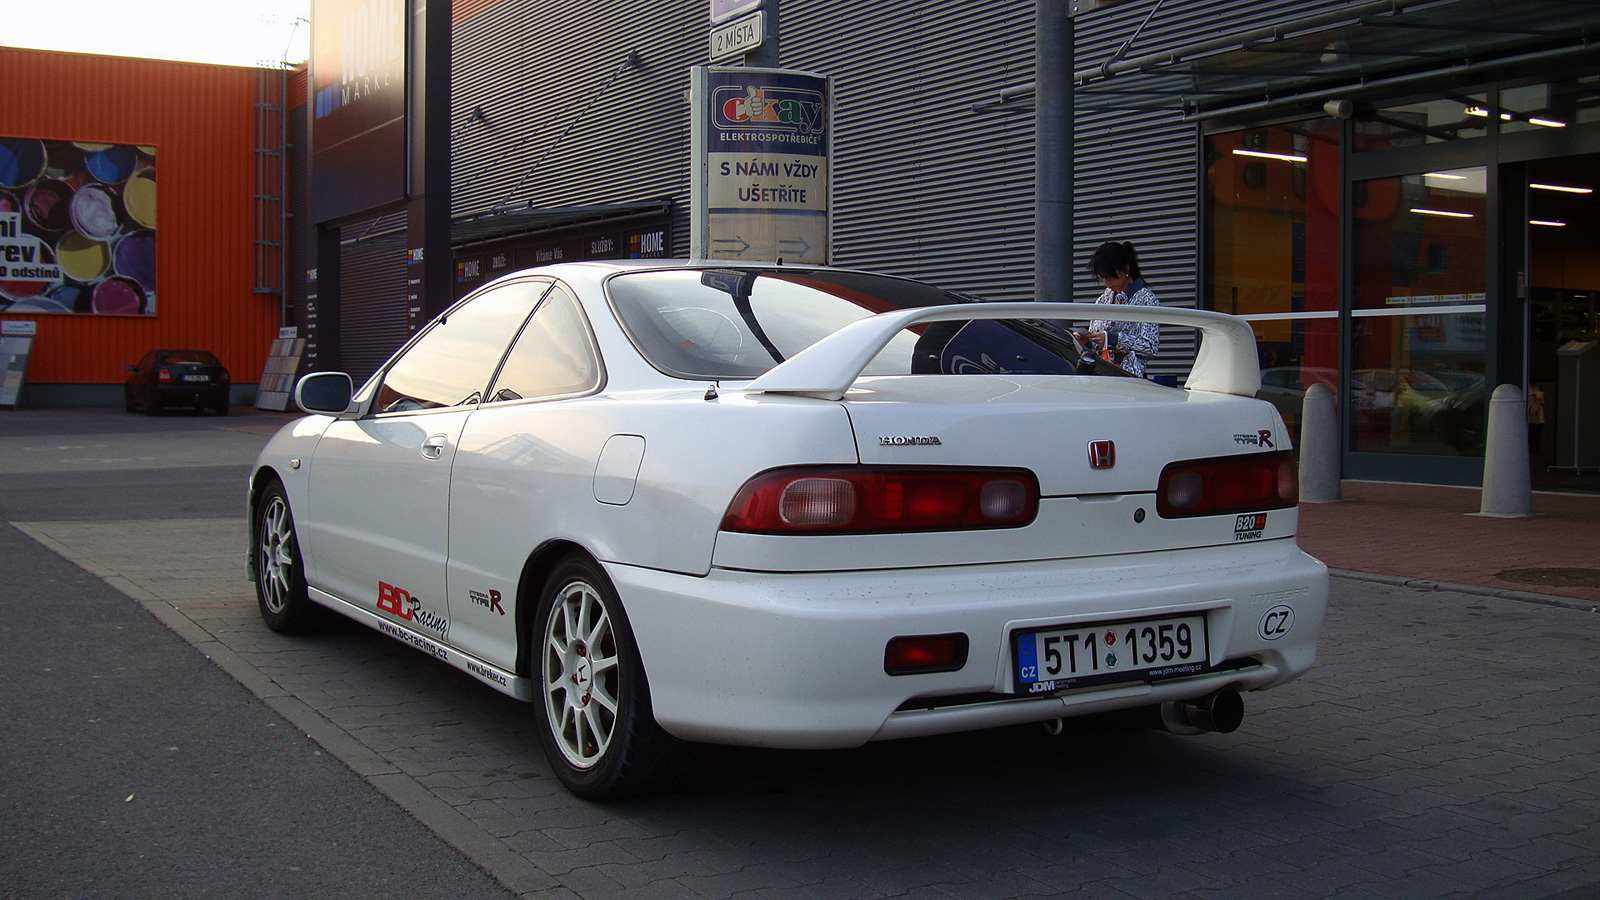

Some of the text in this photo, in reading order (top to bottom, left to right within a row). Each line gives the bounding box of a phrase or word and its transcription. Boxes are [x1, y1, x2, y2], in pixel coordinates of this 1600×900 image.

[717, 23, 754, 52] 2 MÍSTA
[341, 60, 401, 107] MARKET
[720, 132, 818, 145] ELEKTROSPOTŘEBIČE
[720, 158, 818, 178] S NÁMI VŽDY
[738, 183, 807, 203] UŠETŘÍTE
[591, 236, 614, 254] SLUŽBY:
[641, 231, 664, 253] HOME
[879, 435, 942, 446] HONDA
[1258, 430, 1275, 448] R
[1235, 530, 1262, 541] TUNING
[376, 580, 448, 641] BC Racing
[489, 588, 506, 616] R
[1263, 610, 1289, 636] CZ
[378, 621, 448, 660] www.bc-racing.cz
[1044, 622, 1193, 675] 5T1 1359
[1021, 666, 1036, 678] CZ
[1029, 680, 1055, 693] JDM
